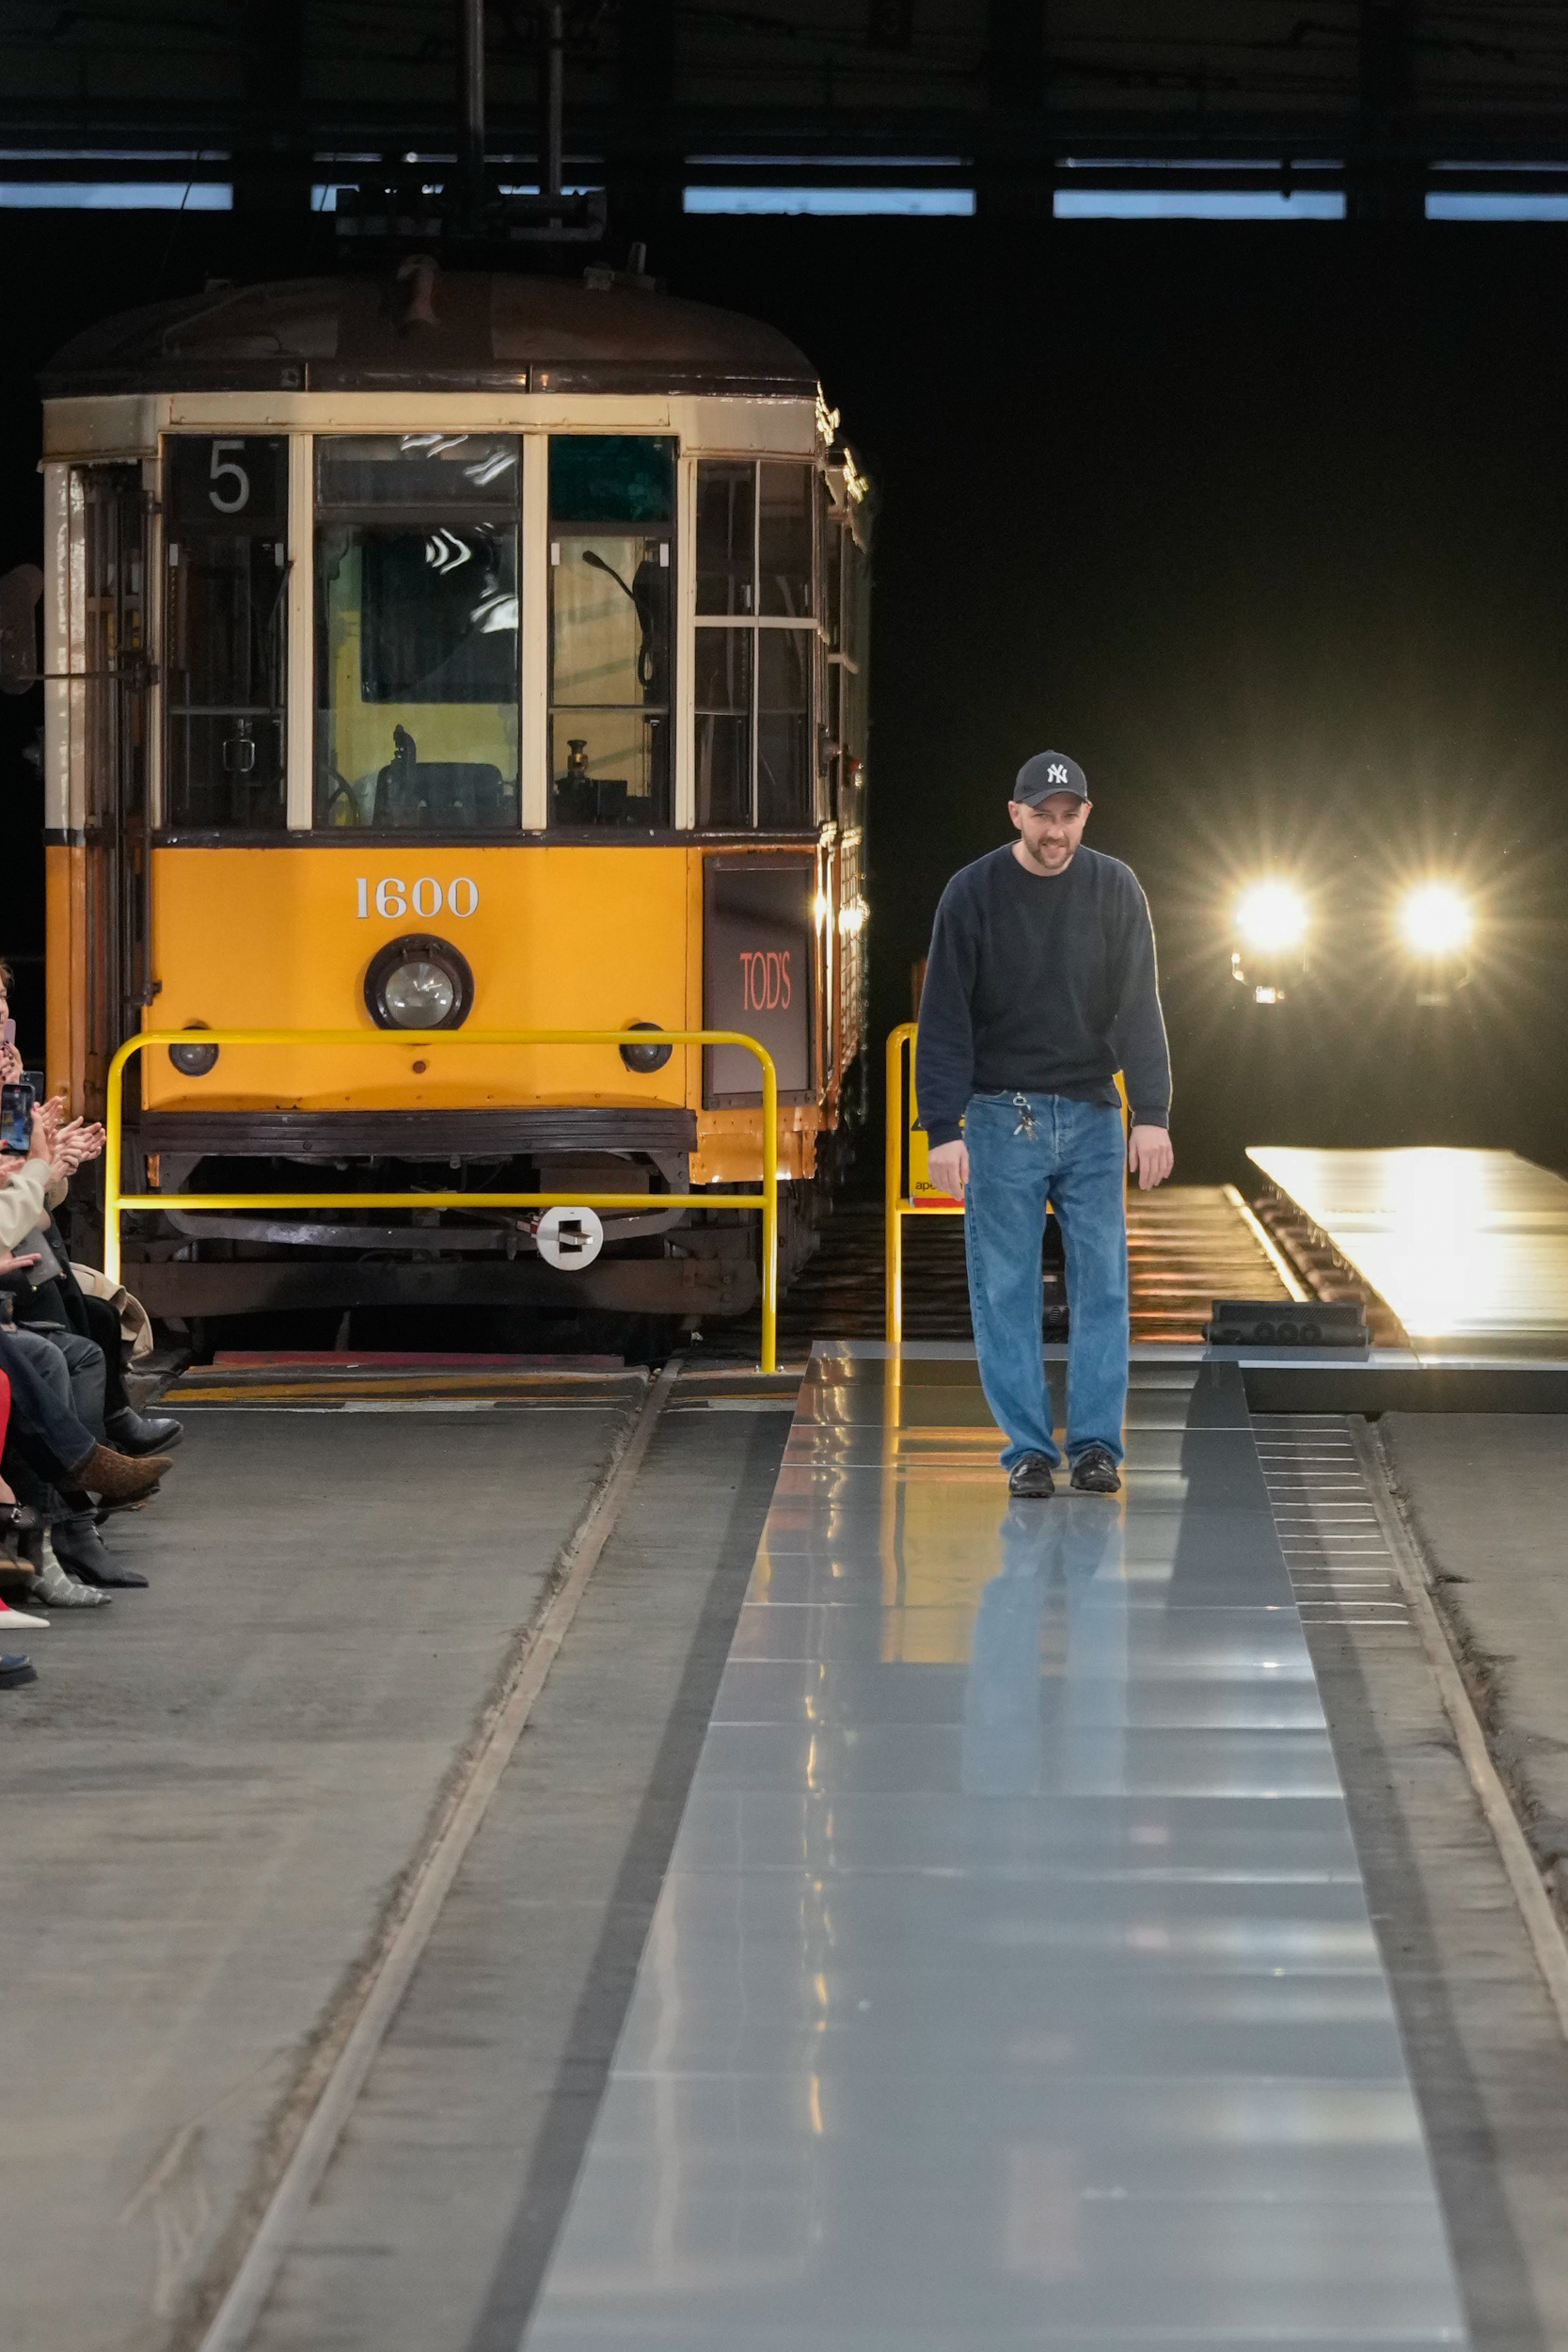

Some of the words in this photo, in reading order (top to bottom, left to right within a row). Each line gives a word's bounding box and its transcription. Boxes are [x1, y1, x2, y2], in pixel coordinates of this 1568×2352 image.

[208, 439, 250, 514] 5
[1047, 763, 1069, 784] NY
[356, 877, 480, 919] 1600
[739, 950, 792, 1011] TOD'S
